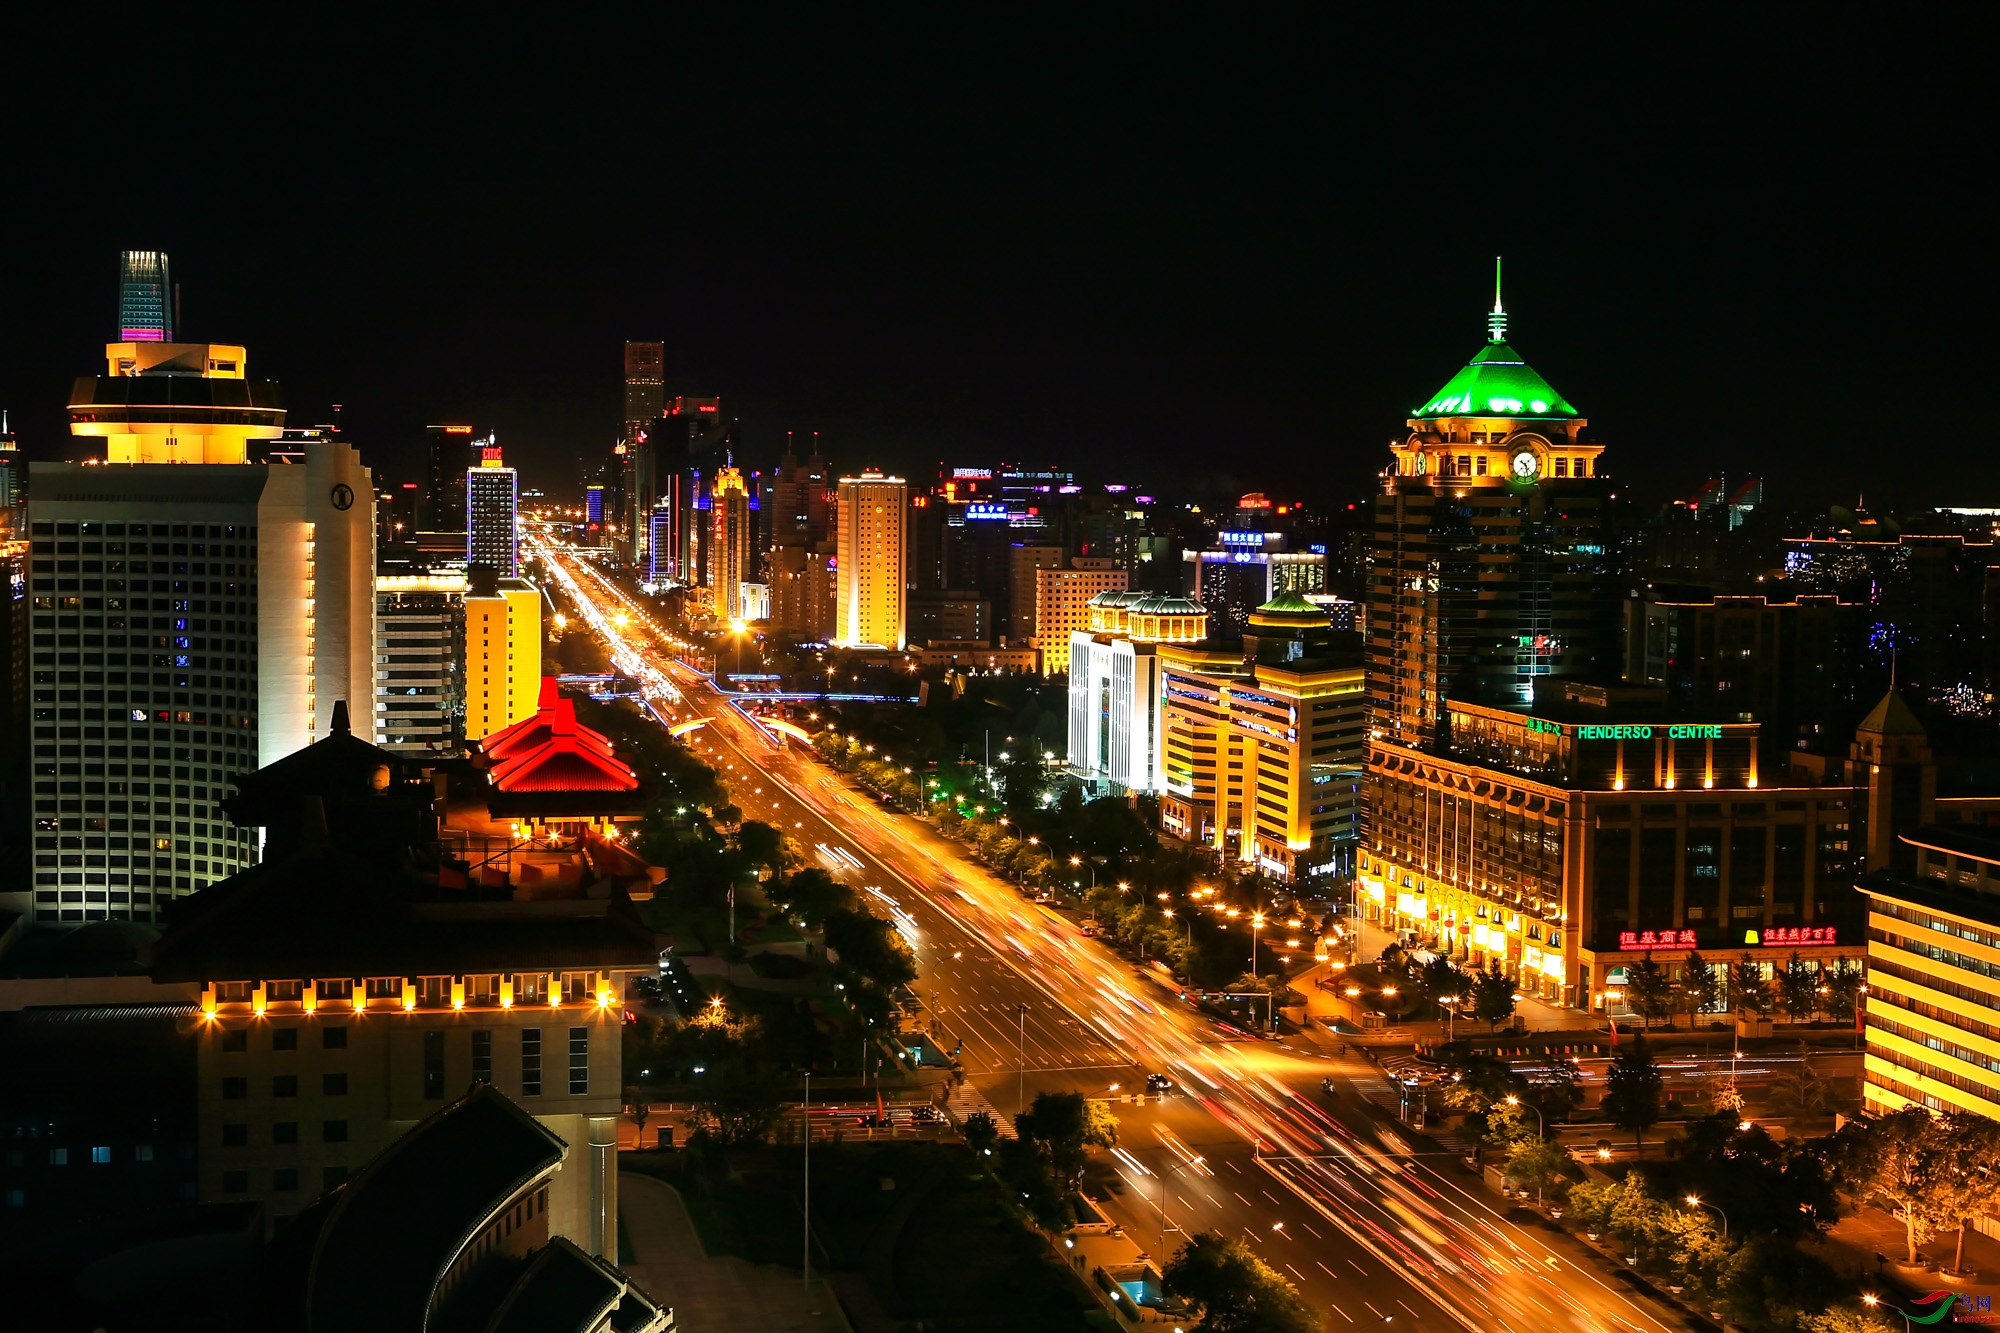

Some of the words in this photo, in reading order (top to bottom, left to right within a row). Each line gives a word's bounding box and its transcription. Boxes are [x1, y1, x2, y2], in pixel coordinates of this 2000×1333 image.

[483, 447, 502, 460] CITIC
[1527, 717, 1562, 737] 恒基中心
[1578, 726, 1651, 739] HENDERSO
[1669, 726, 1722, 739] CENTRE
[1620, 929, 1697, 944] 恒基商城
